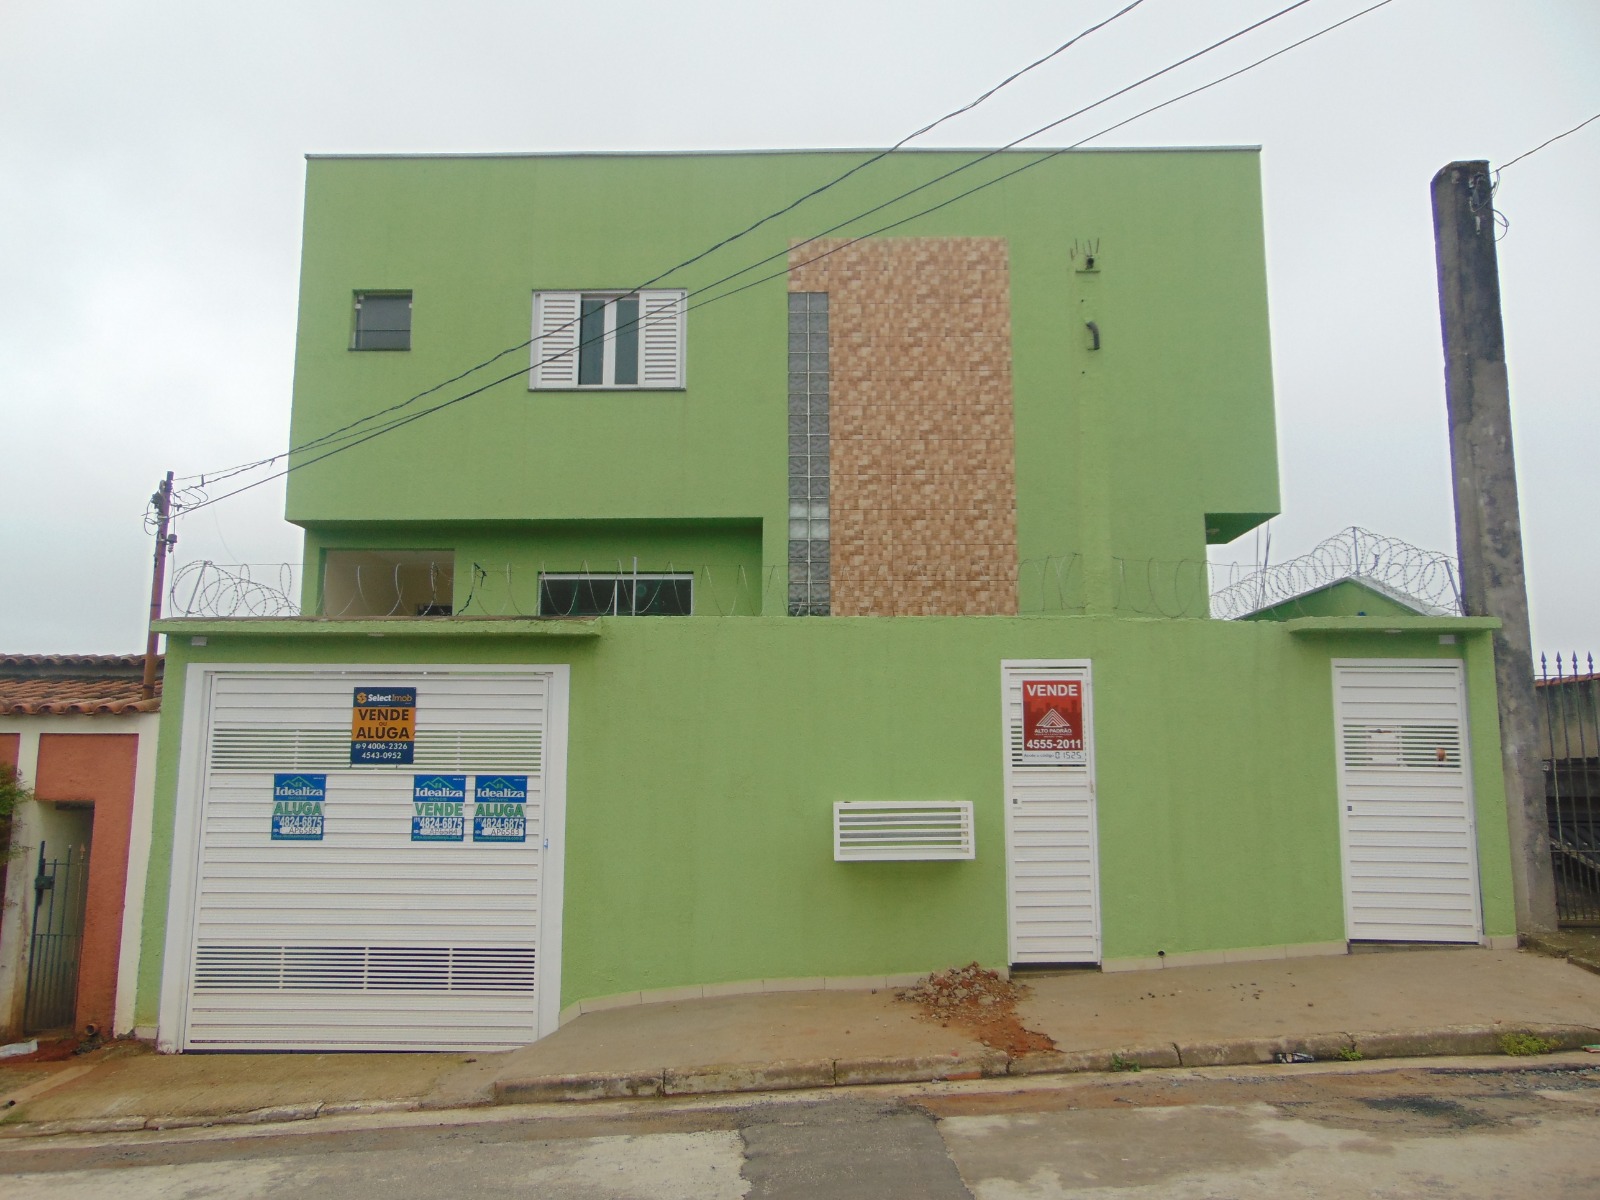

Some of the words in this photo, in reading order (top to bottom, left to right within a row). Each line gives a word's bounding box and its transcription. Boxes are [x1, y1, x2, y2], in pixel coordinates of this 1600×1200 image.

[1026, 684, 1078, 697] VENDE
[358, 709, 409, 721] VENDE
[356, 727, 410, 739] ALUGA
[1026, 739, 1081, 749] 4555-2011
[275, 786, 323, 796] Idealiza
[415, 787, 463, 797] Idealiza
[476, 788, 525, 798] Idealiza
[274, 802, 322, 815] ALUGA
[415, 803, 463, 816] VENDE
[475, 803, 524, 816] ALUGA
[279, 816, 322, 828] 4824-6875
[420, 817, 463, 829] 4824-6875
[482, 818, 524, 829] 4824-6875
[490, 828, 520, 836] AP6583
